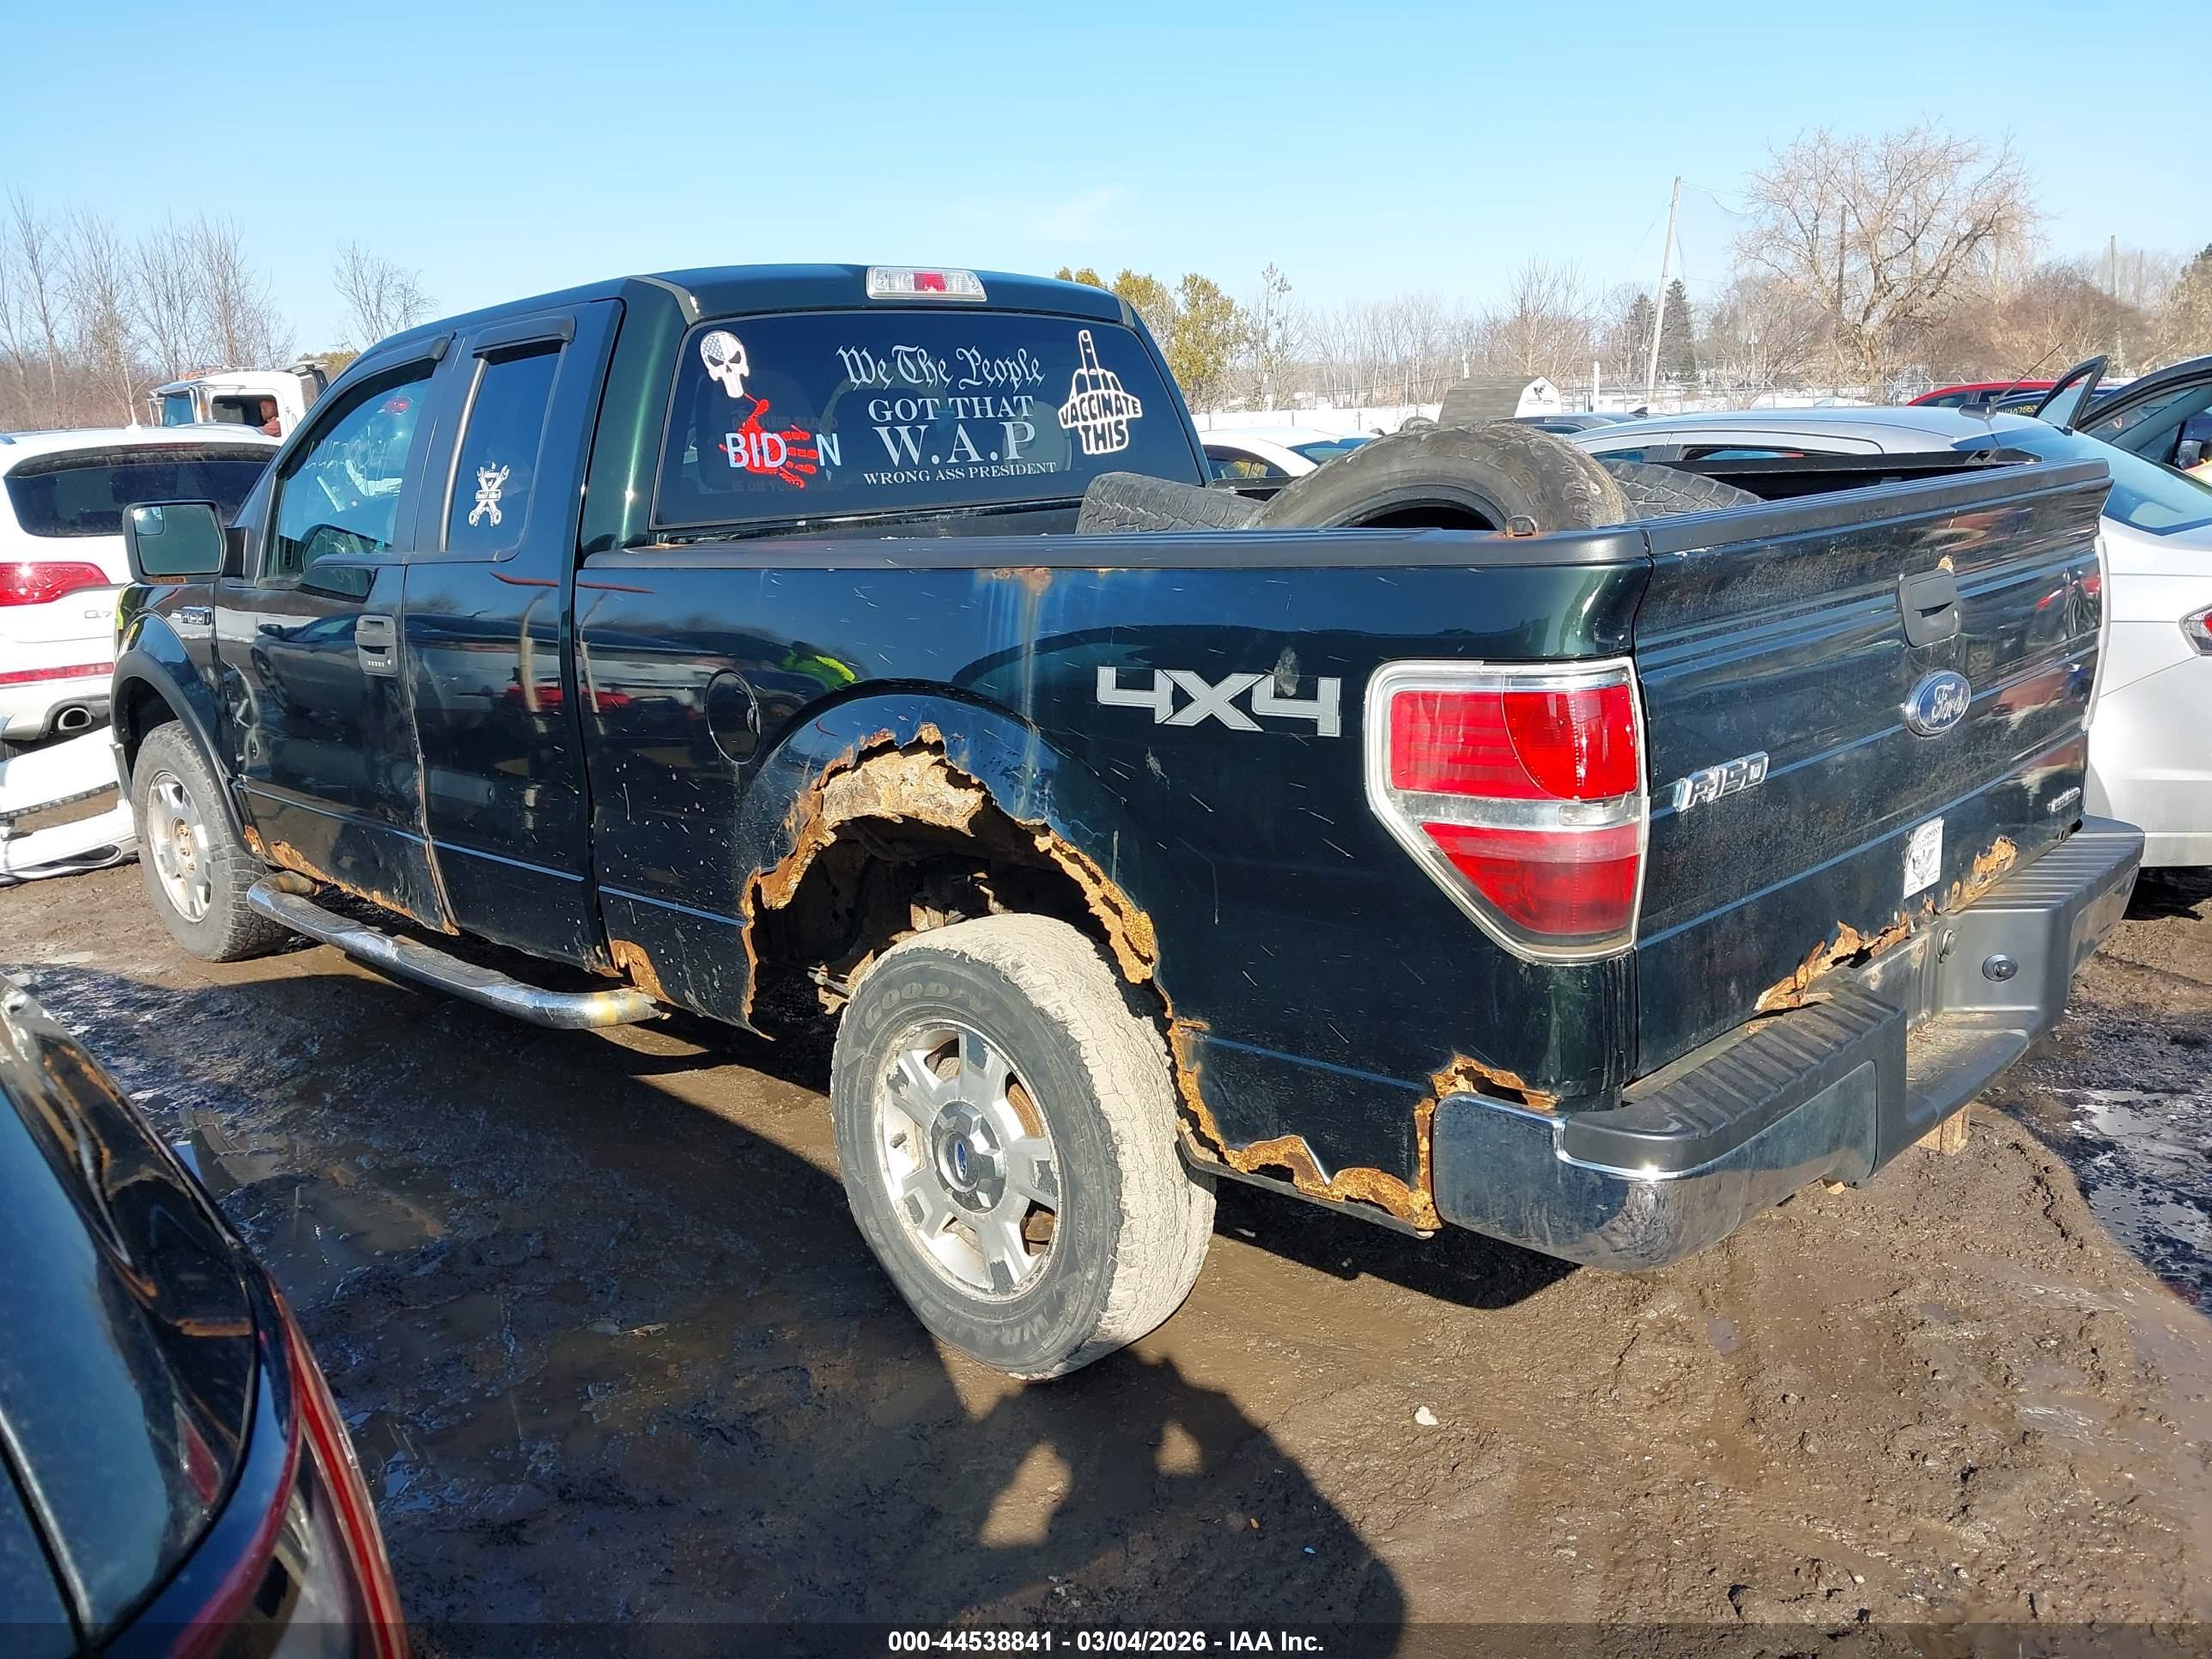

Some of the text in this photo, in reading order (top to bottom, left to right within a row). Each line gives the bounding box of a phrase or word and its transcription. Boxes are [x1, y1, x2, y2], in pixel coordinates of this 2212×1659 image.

[836, 345, 1046, 392] We The People
[868, 395, 1034, 422] GOT THAT
[1060, 392, 1139, 425] VACCINATE
[1081, 420, 1126, 451] THIS
[864, 462, 1057, 484] WRONG ASS PRESIDENT
